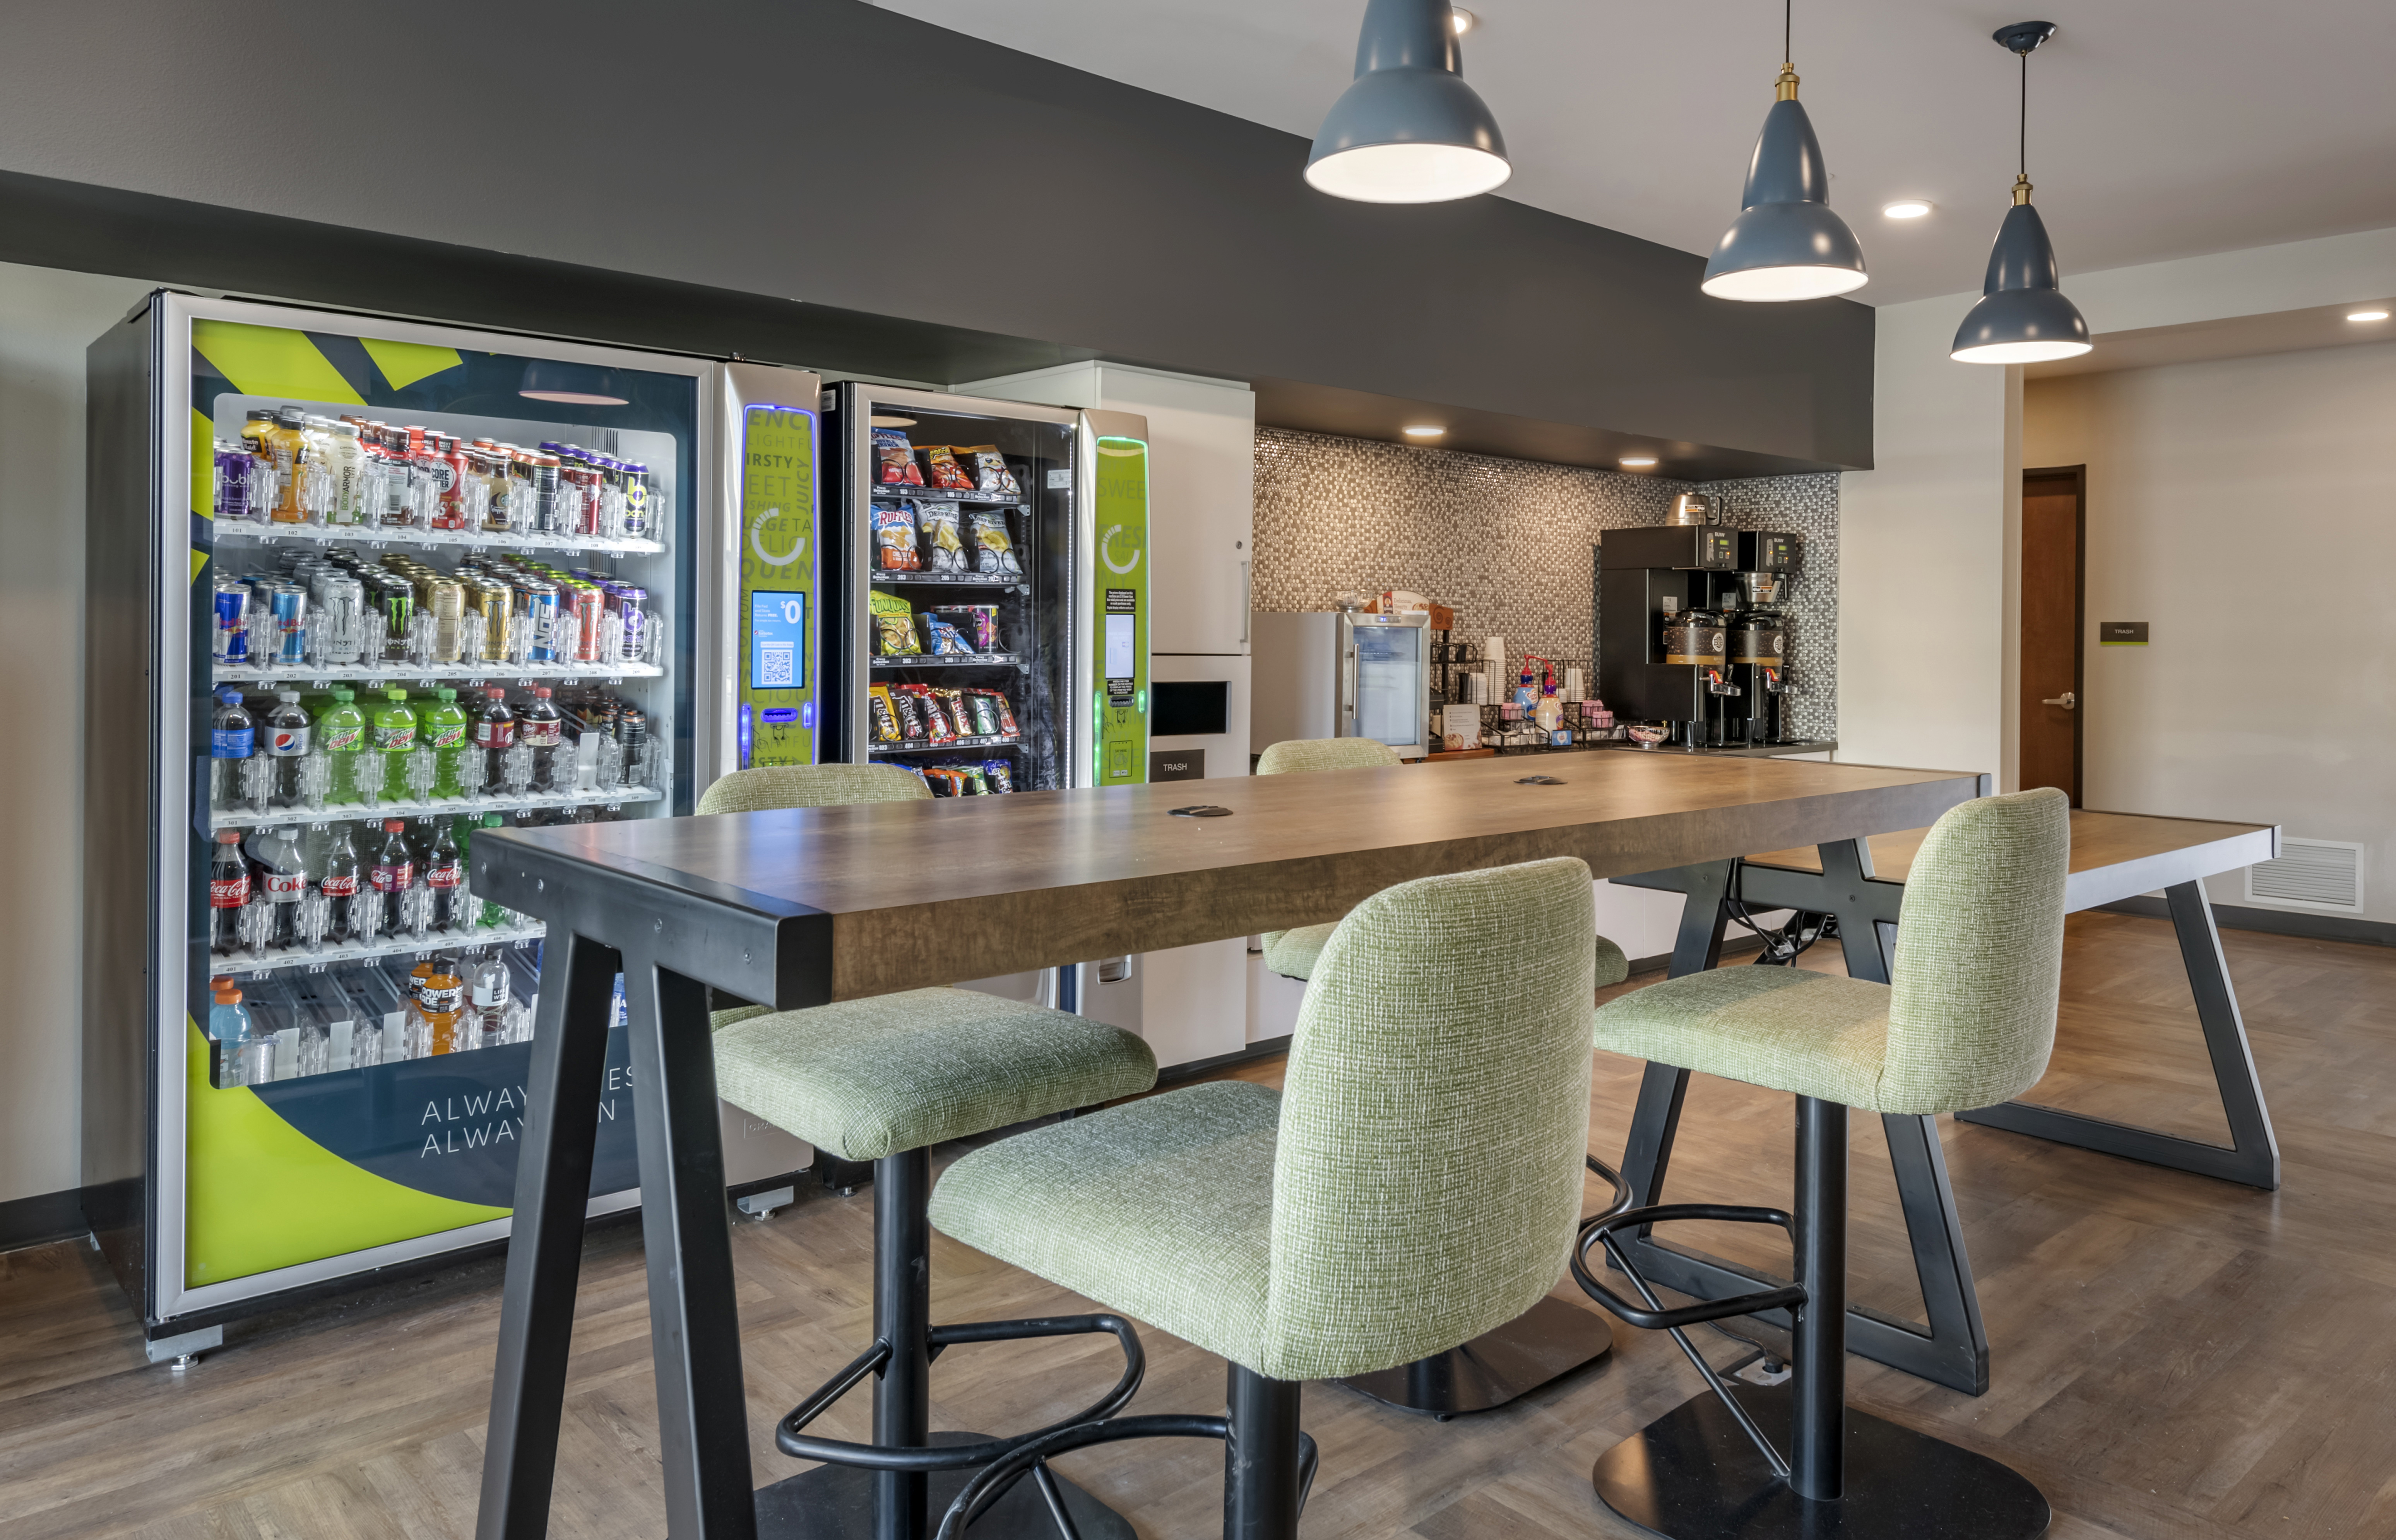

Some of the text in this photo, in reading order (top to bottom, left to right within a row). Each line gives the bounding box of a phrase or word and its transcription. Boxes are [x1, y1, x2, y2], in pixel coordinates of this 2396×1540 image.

[431, 468, 449, 480] CORE
[342, 466, 352, 510] BODYARMOR
[880, 511, 913, 525] RUFFLES
[945, 512, 958, 521] RIVER
[870, 597, 910, 614] FUNYUNS
[532, 597, 553, 649] NOS
[952, 696, 970, 728] TWIX
[1163, 763, 1187, 771] TRASH
[427, 865, 462, 881] Coca-Cola
[268, 877, 307, 892] Coke
[321, 874, 359, 890] Coca-Cola
[422, 988, 456, 998] POWER
[421, 1085, 527, 1126] ALWAY
[421, 1117, 524, 1158] ALWA
